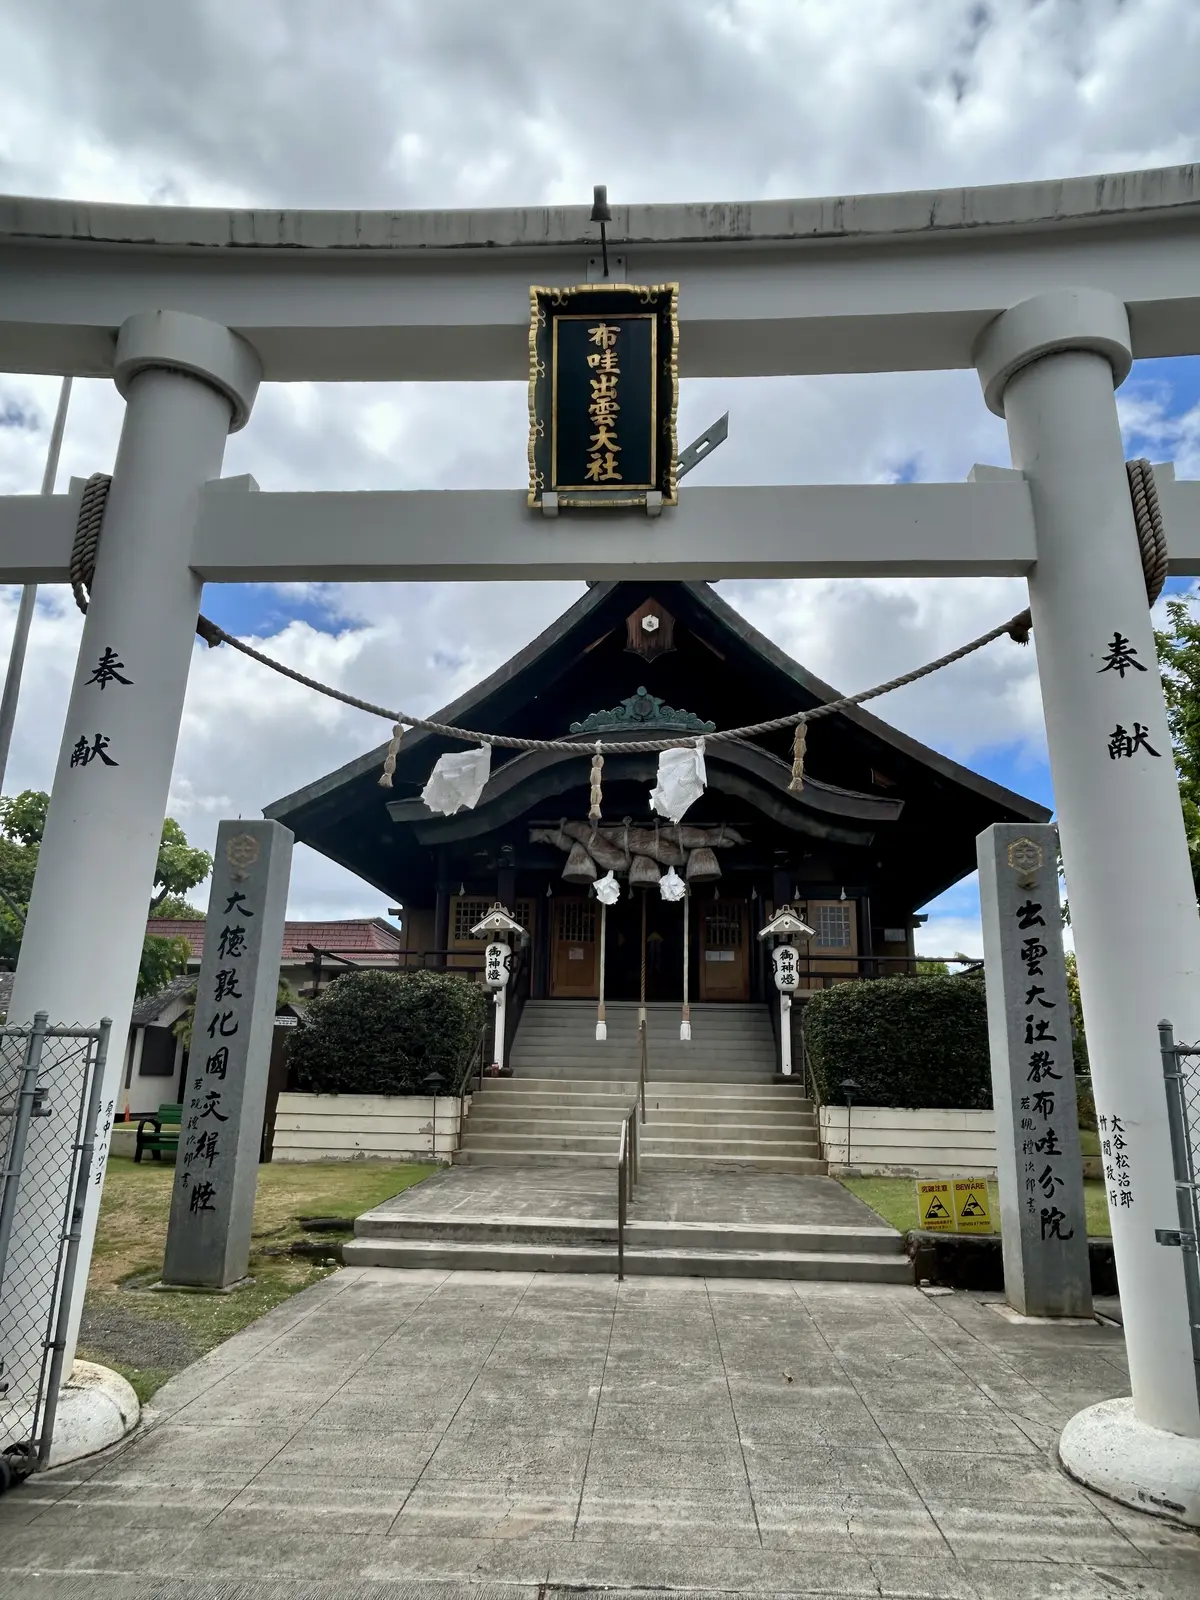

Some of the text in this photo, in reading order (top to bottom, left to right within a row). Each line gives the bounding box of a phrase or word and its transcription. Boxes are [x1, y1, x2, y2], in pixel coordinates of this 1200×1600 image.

[584, 322, 623, 482] 布哇出雲大社
[70, 646, 134, 768] 奉献
[1096, 632, 1162, 760] 奉献
[780, 949, 796, 985] 御神燈
[955, 1182, 985, 1191] BEWARE
[1110, 1114, 1134, 1209] 大谷松治郎
